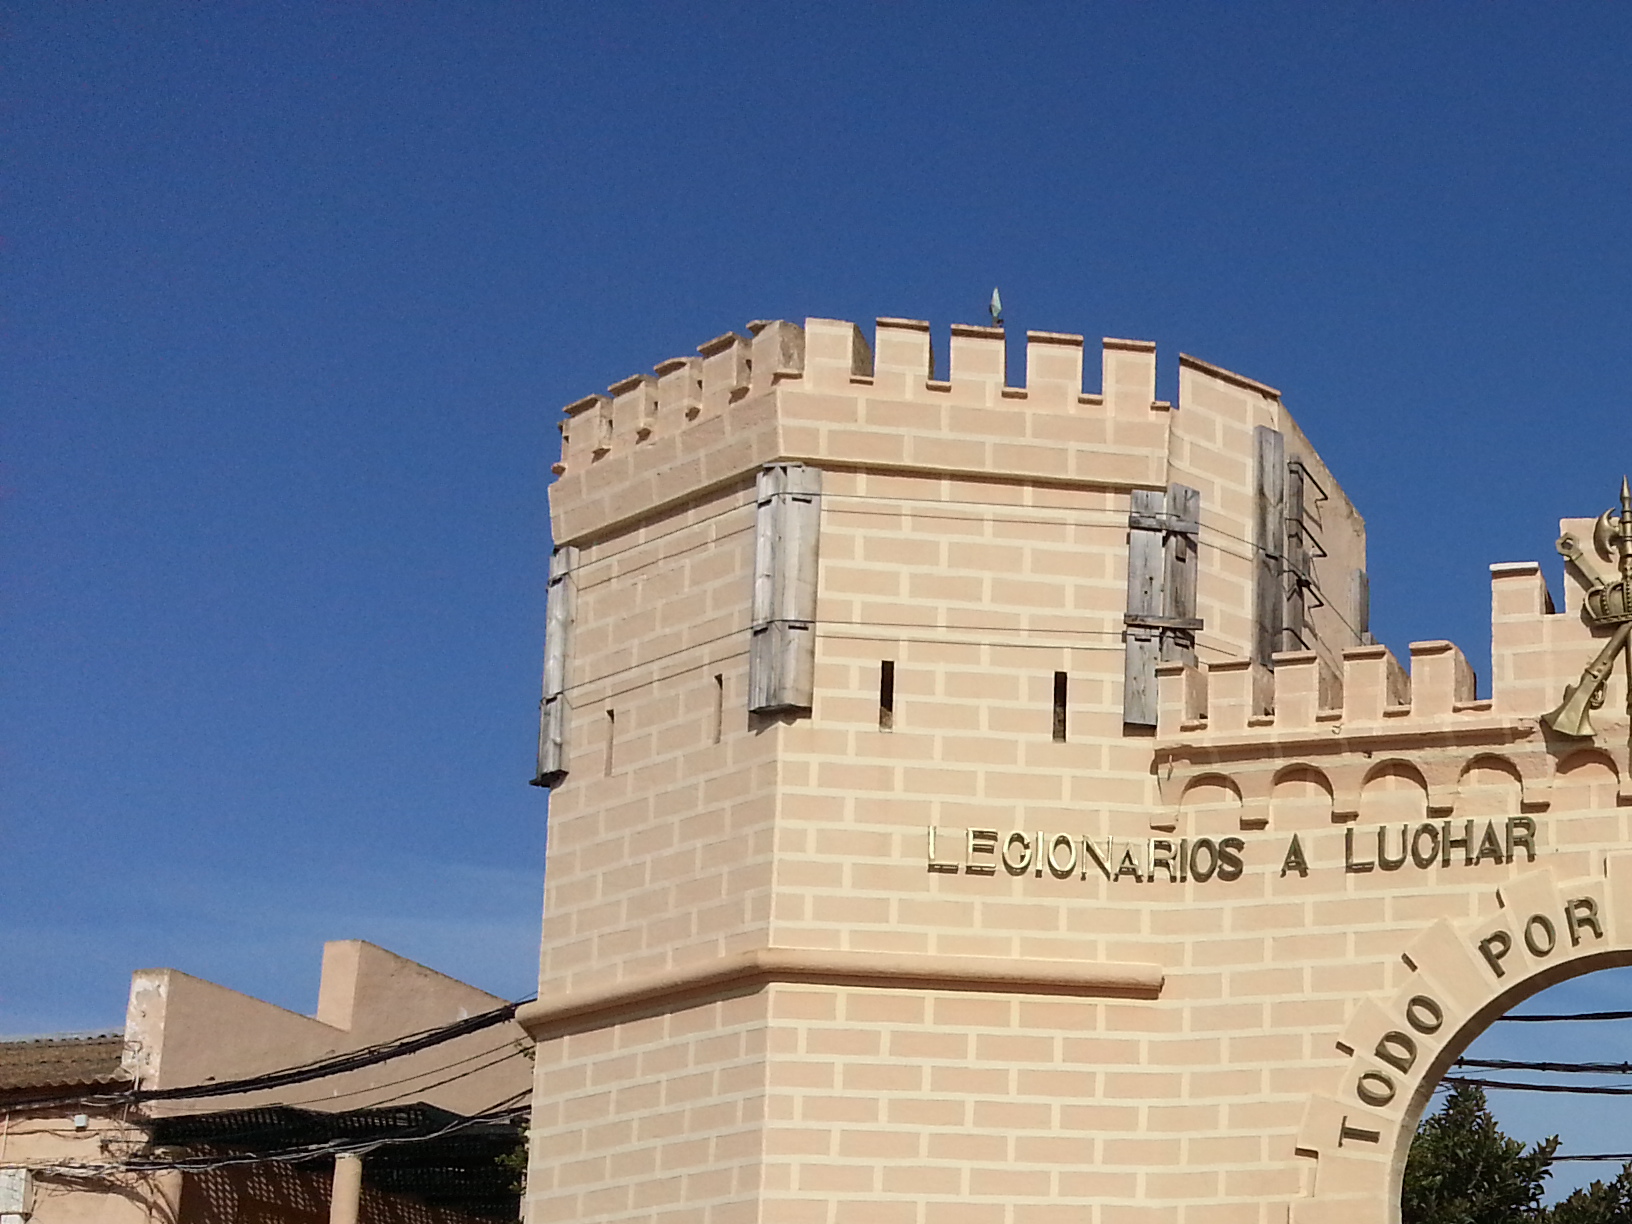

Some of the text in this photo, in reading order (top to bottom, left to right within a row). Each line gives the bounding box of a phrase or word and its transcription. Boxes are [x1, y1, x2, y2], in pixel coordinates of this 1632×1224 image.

[927, 815, 1537, 882] LEGIONARIOS A LUCHAR
[1338, 994, 1444, 1148] TODO
[1478, 895, 1604, 979] POR
